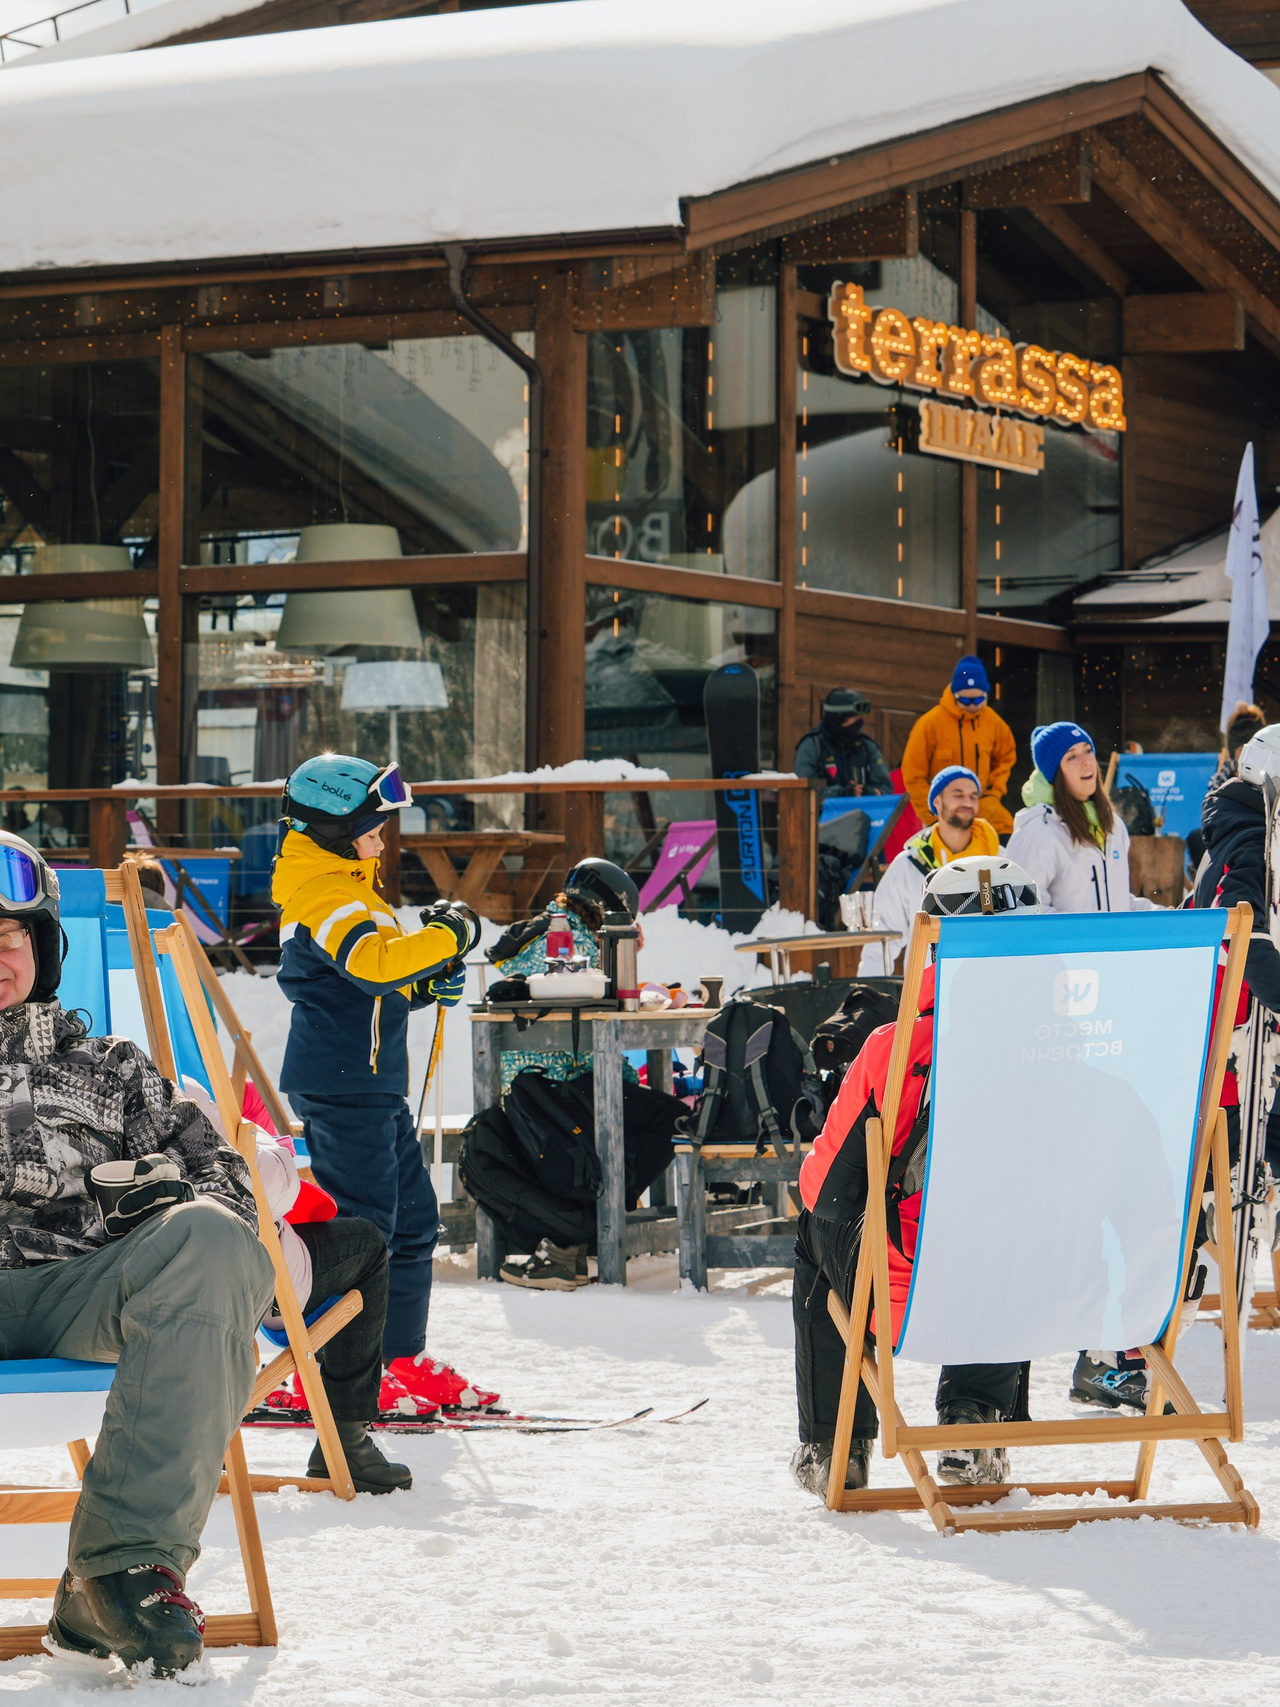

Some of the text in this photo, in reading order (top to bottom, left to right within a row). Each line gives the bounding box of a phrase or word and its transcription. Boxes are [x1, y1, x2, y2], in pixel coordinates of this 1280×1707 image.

[829, 281, 1127, 433] terrassa
[321, 781, 353, 802] bollé
[981, 881, 991, 906] bollé
